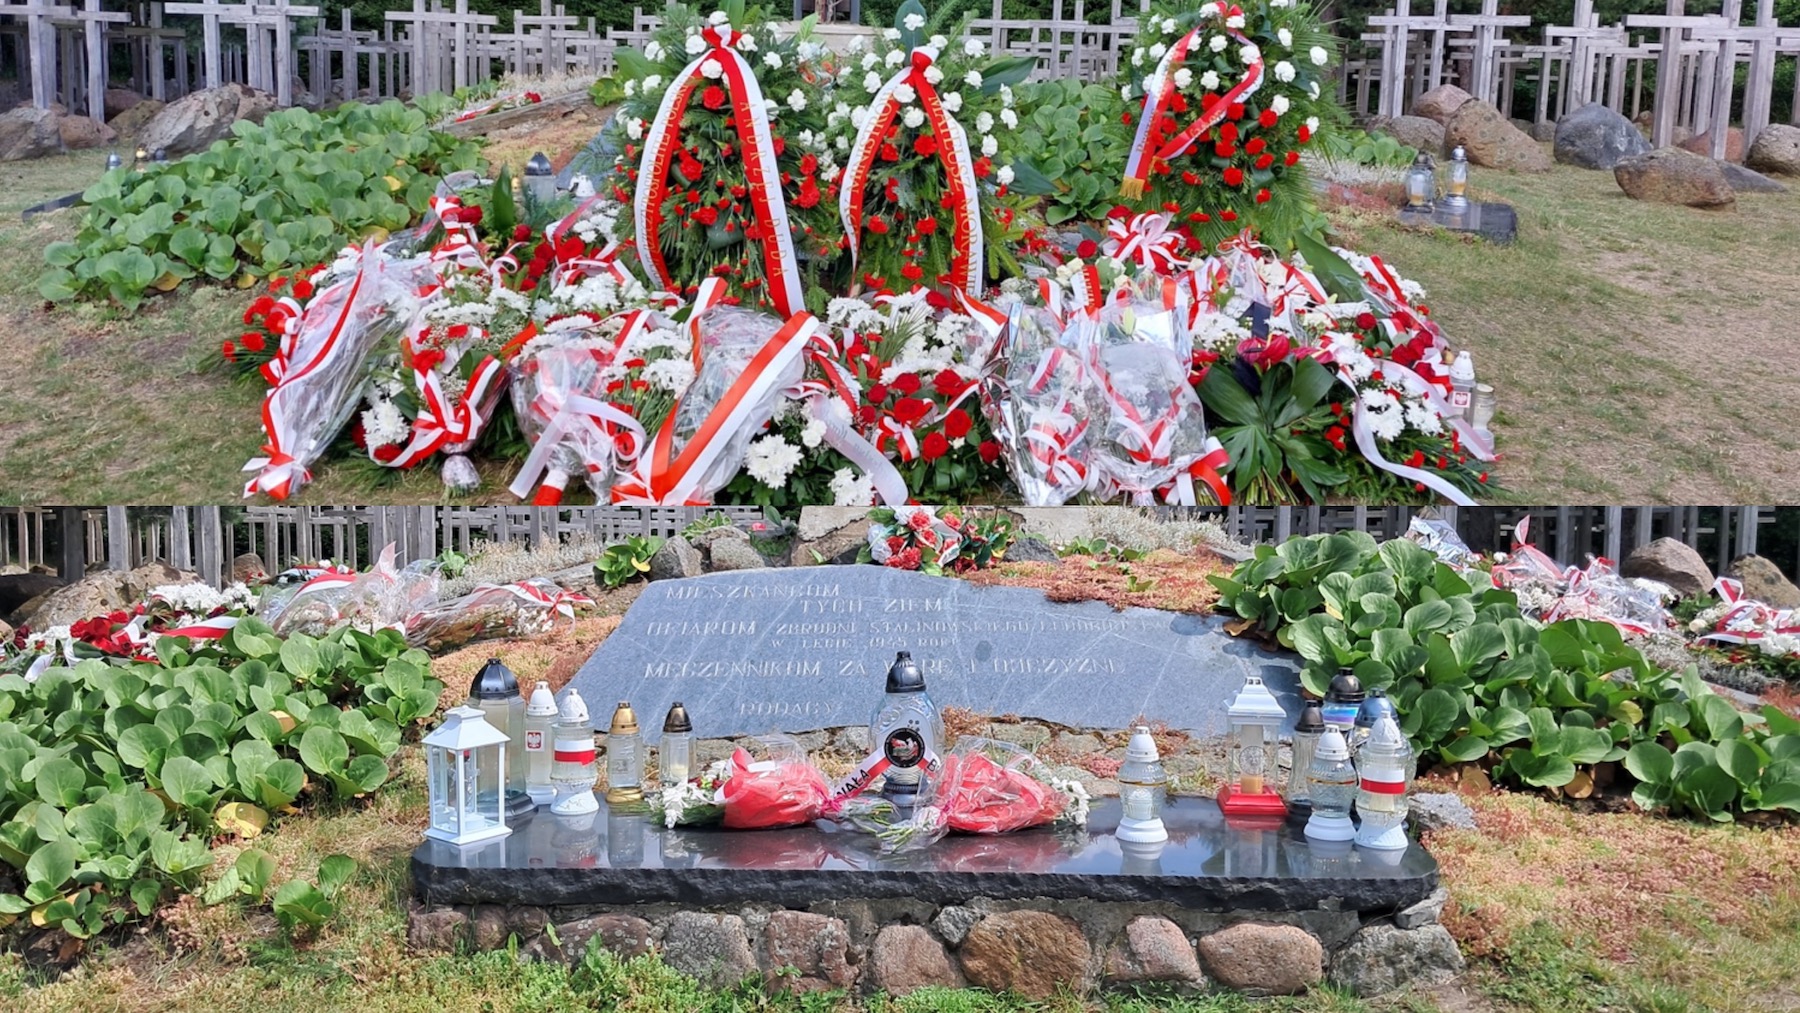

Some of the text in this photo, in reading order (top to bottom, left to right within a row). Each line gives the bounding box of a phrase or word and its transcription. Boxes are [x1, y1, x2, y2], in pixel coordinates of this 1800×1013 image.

[739, 100, 789, 277] ANDRZEJ DUDA
[926, 94, 977, 294] MATEUSZ MORAWIE
[800, 597, 942, 615] TYCH ZIEM
[837, 659, 867, 676] ZA
